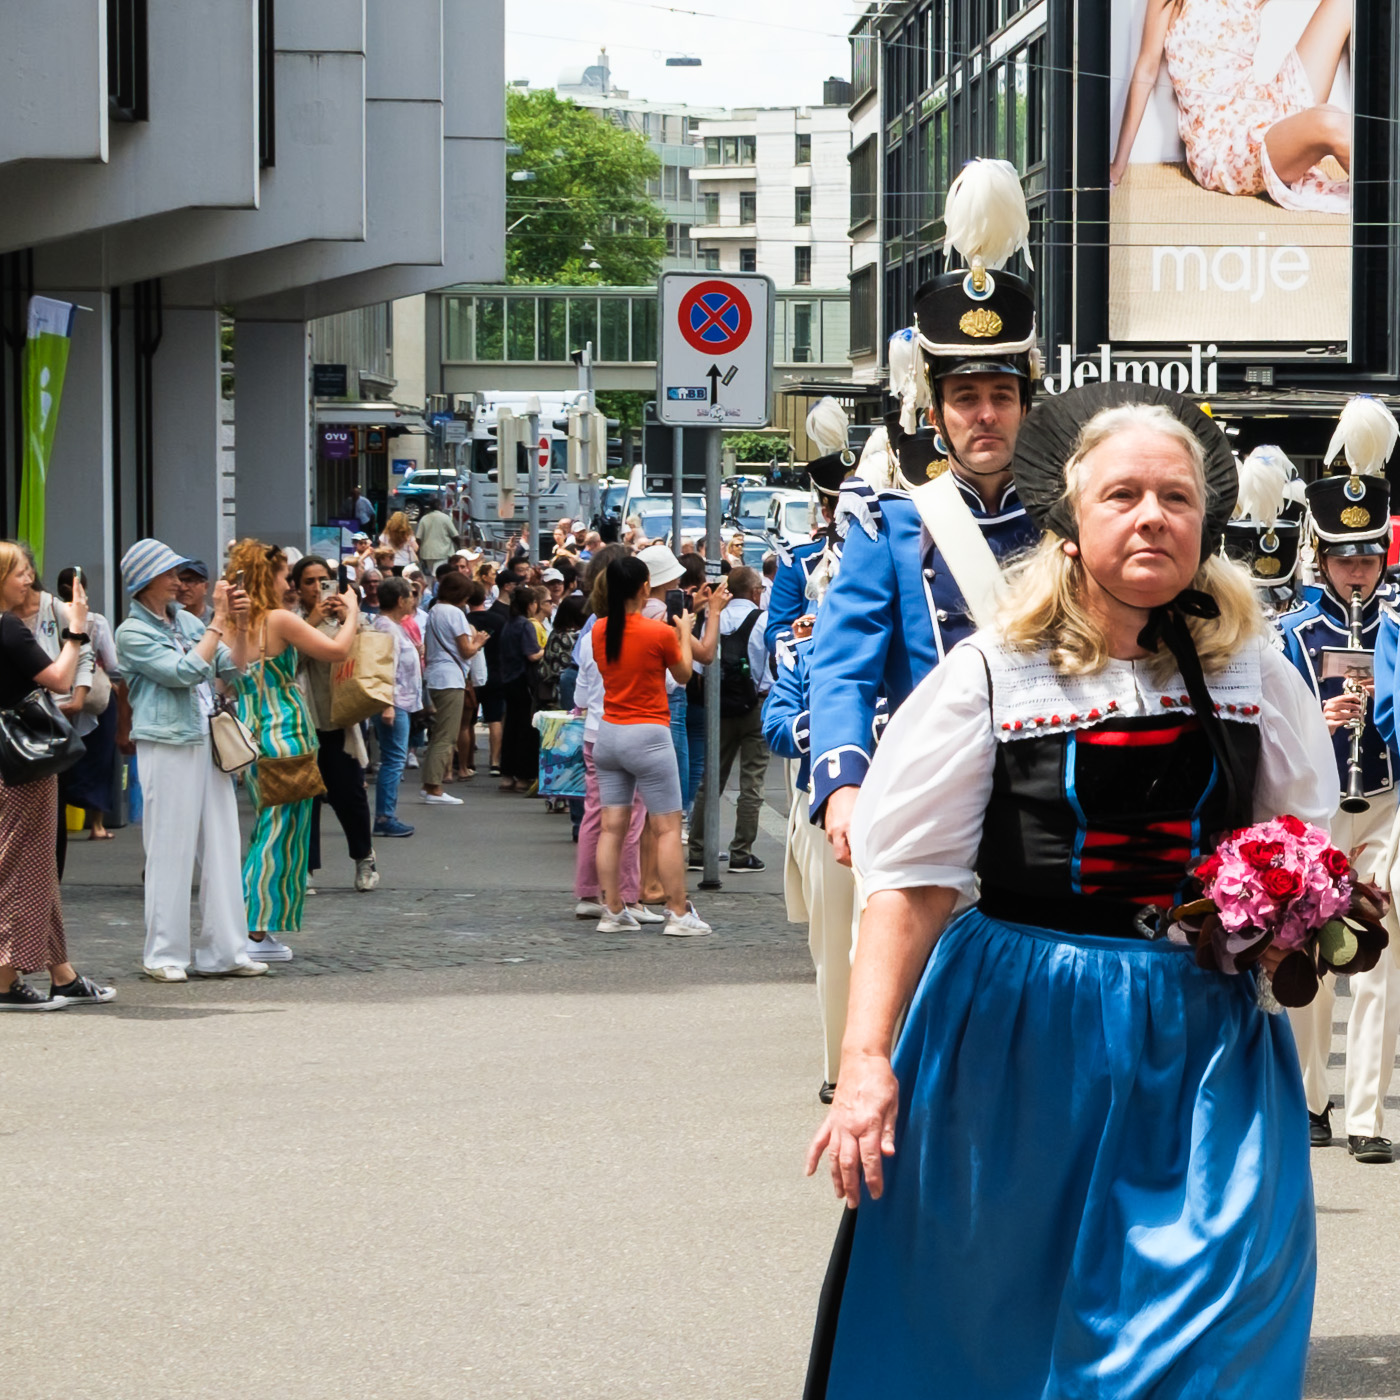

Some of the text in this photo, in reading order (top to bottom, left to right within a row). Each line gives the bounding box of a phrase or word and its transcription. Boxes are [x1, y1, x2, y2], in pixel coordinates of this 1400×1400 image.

[1152, 231, 1310, 303] maje
[1043, 343, 1218, 396] Jelmoli
[325, 432, 348, 441] OYU
